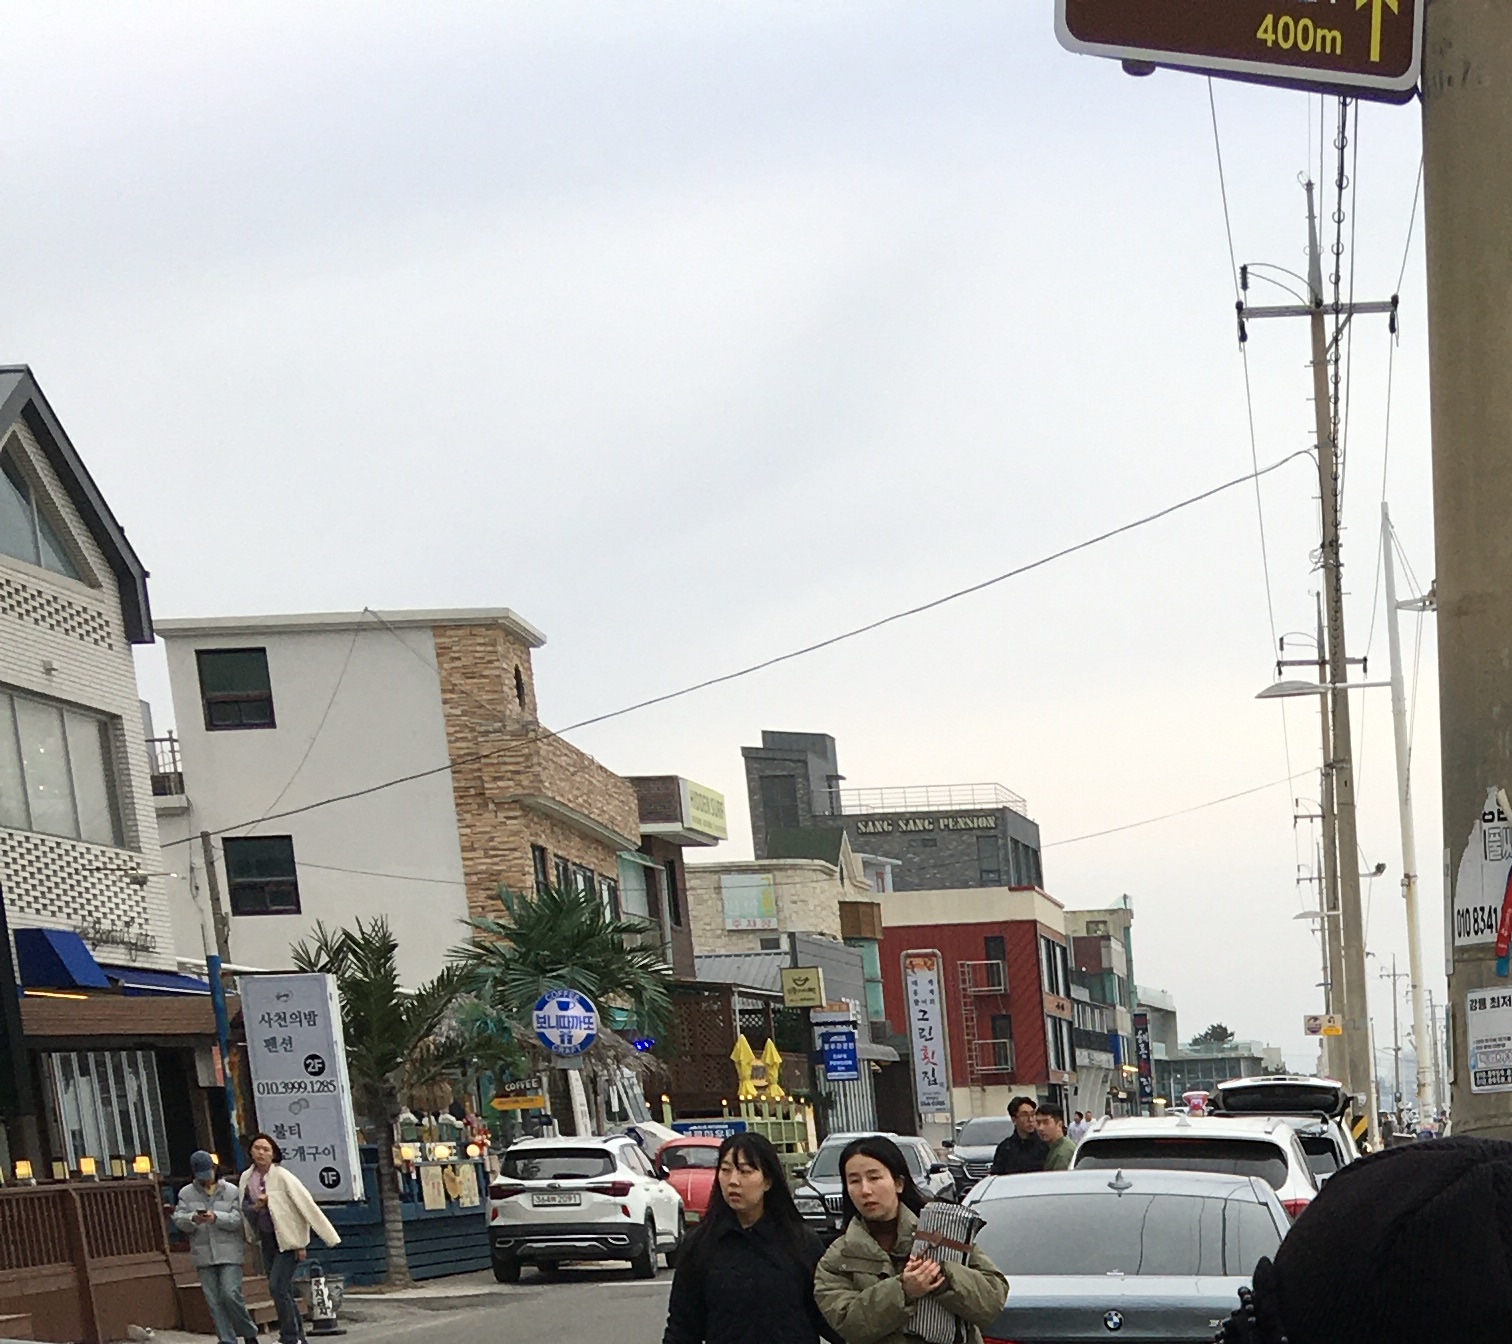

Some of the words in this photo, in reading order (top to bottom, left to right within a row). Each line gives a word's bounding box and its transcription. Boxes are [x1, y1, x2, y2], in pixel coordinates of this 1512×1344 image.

[1256, 14, 1342, 55] 400m
[857, 819, 893, 834] SANG
[898, 817, 934, 832] SANG
[939, 815, 996, 830] PENSION
[1456, 908, 1471, 938] 010
[1473, 904, 1498, 935] 8341
[545, 987, 580, 1001] COFFEE
[258, 1010, 319, 1029] 사천의밤
[535, 1014, 595, 1031] 보니따까또
[263, 1035, 294, 1054] 펜션
[551, 1044, 582, 1055] CRAFT
[305, 1058, 324, 1073] 2F
[256, 1080, 337, 1096] 010.3999.1285
[504, 1078, 539, 1092] COFFEE
[321, 1171, 338, 1185] 1F
